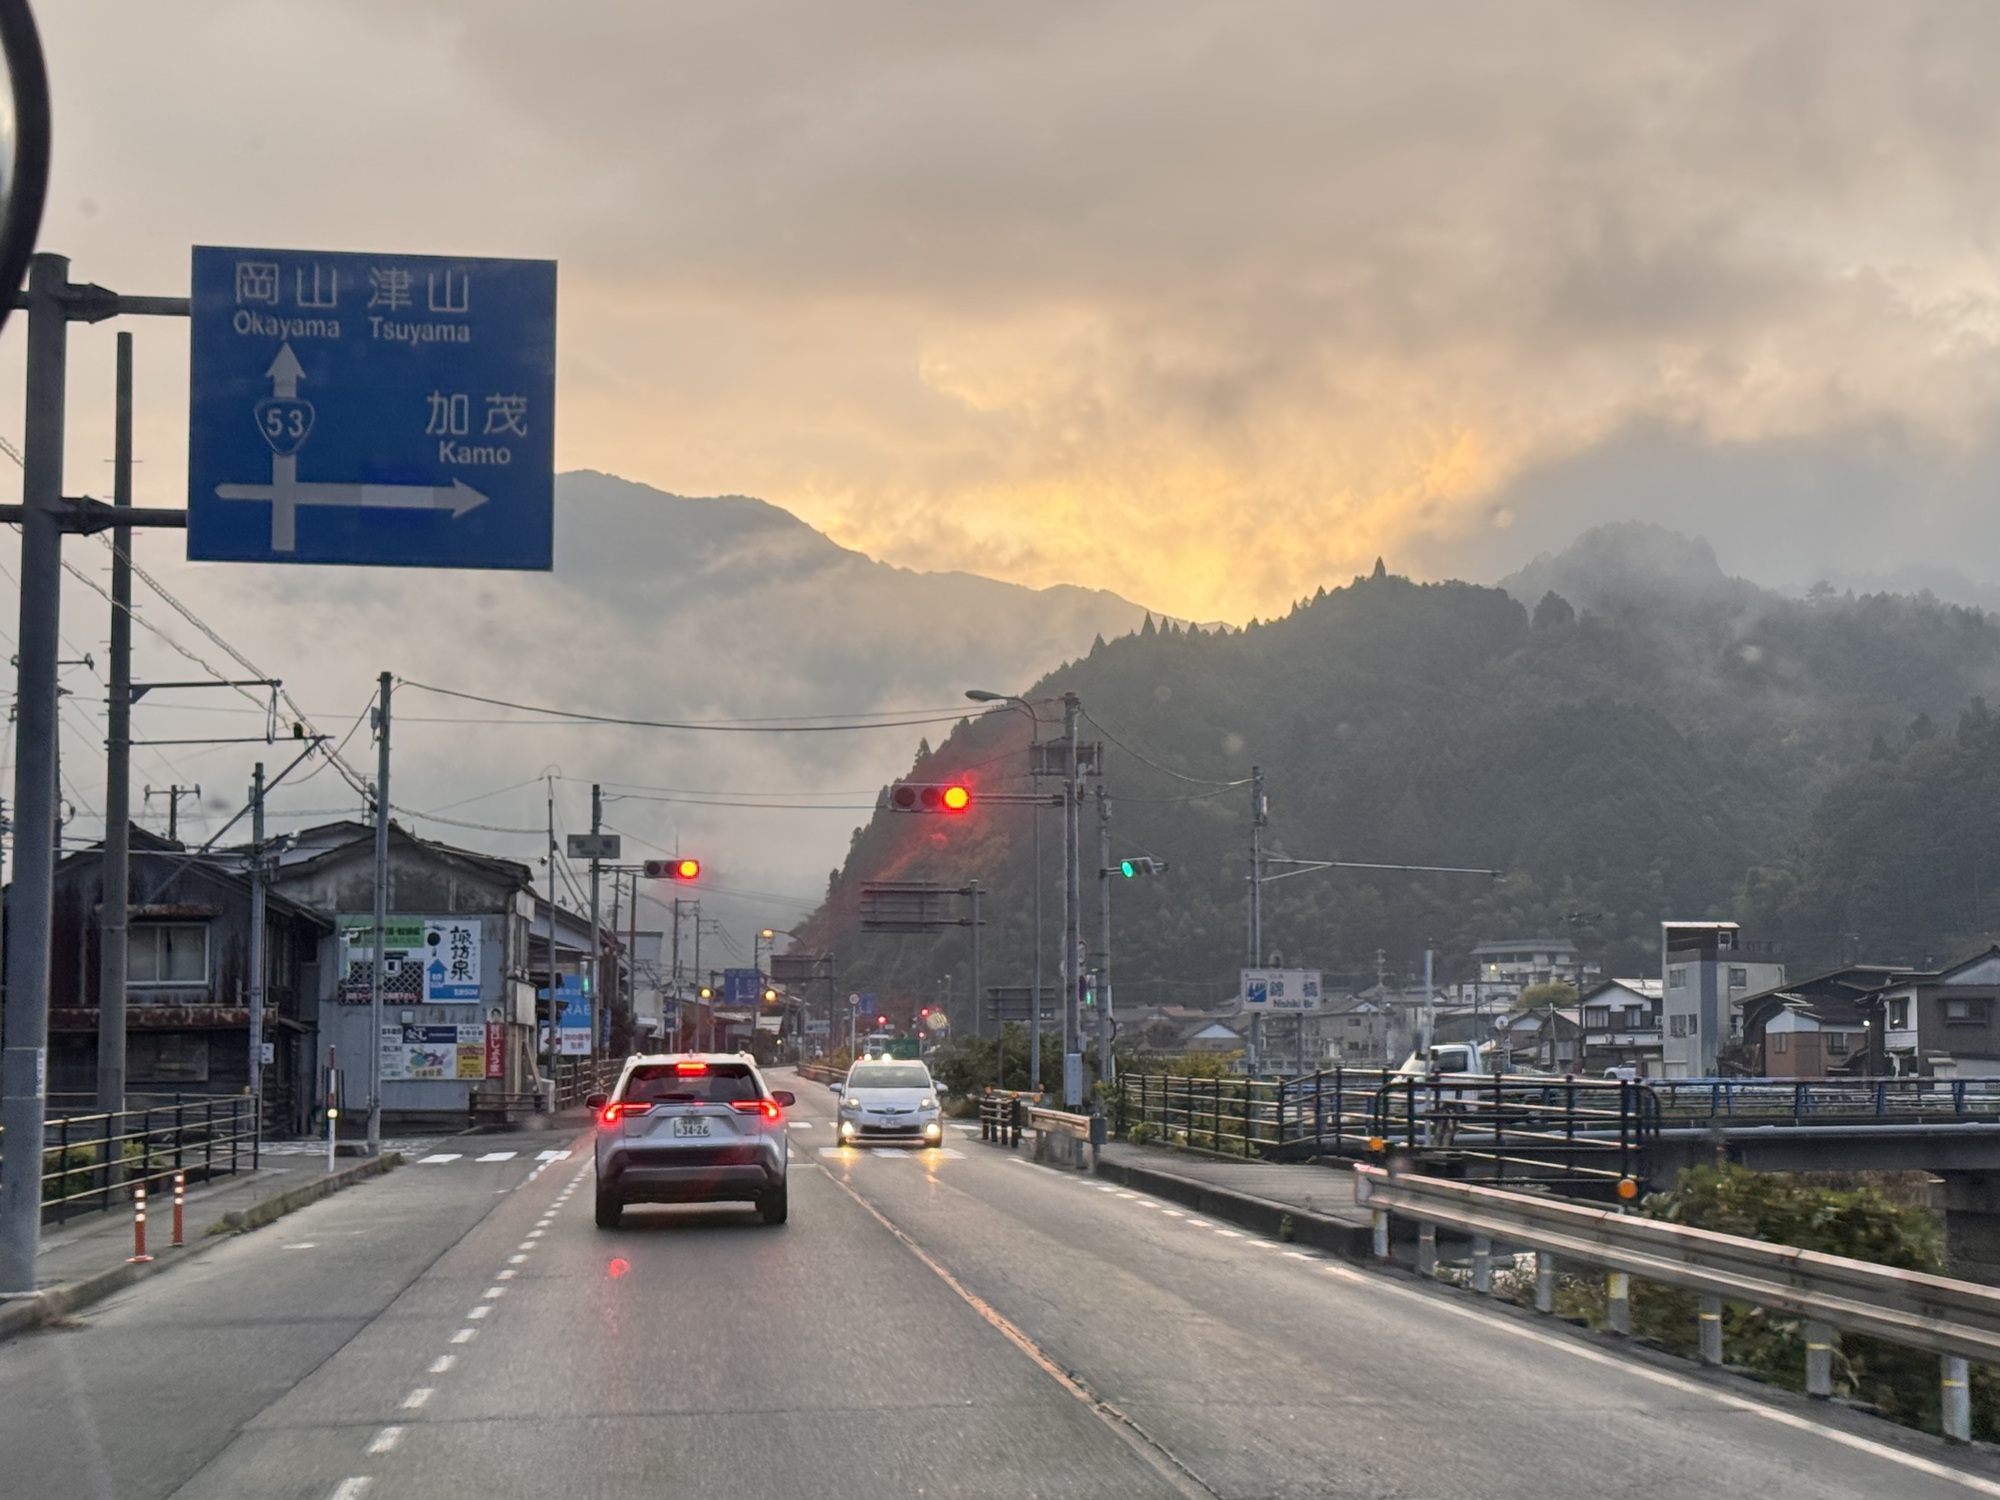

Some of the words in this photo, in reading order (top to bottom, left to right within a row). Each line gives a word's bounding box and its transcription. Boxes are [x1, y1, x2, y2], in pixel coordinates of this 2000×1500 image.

[235, 262, 337, 308] 岡山
[367, 266, 469, 313] 津山
[233, 310, 340, 340] Okayama
[368, 315, 471, 346] Tsuyama
[266, 408, 304, 438] 53
[425, 389, 528, 437] 加茂
[438, 441, 511, 465] Kamo
[682, 1125, 709, 1135] 34-26
